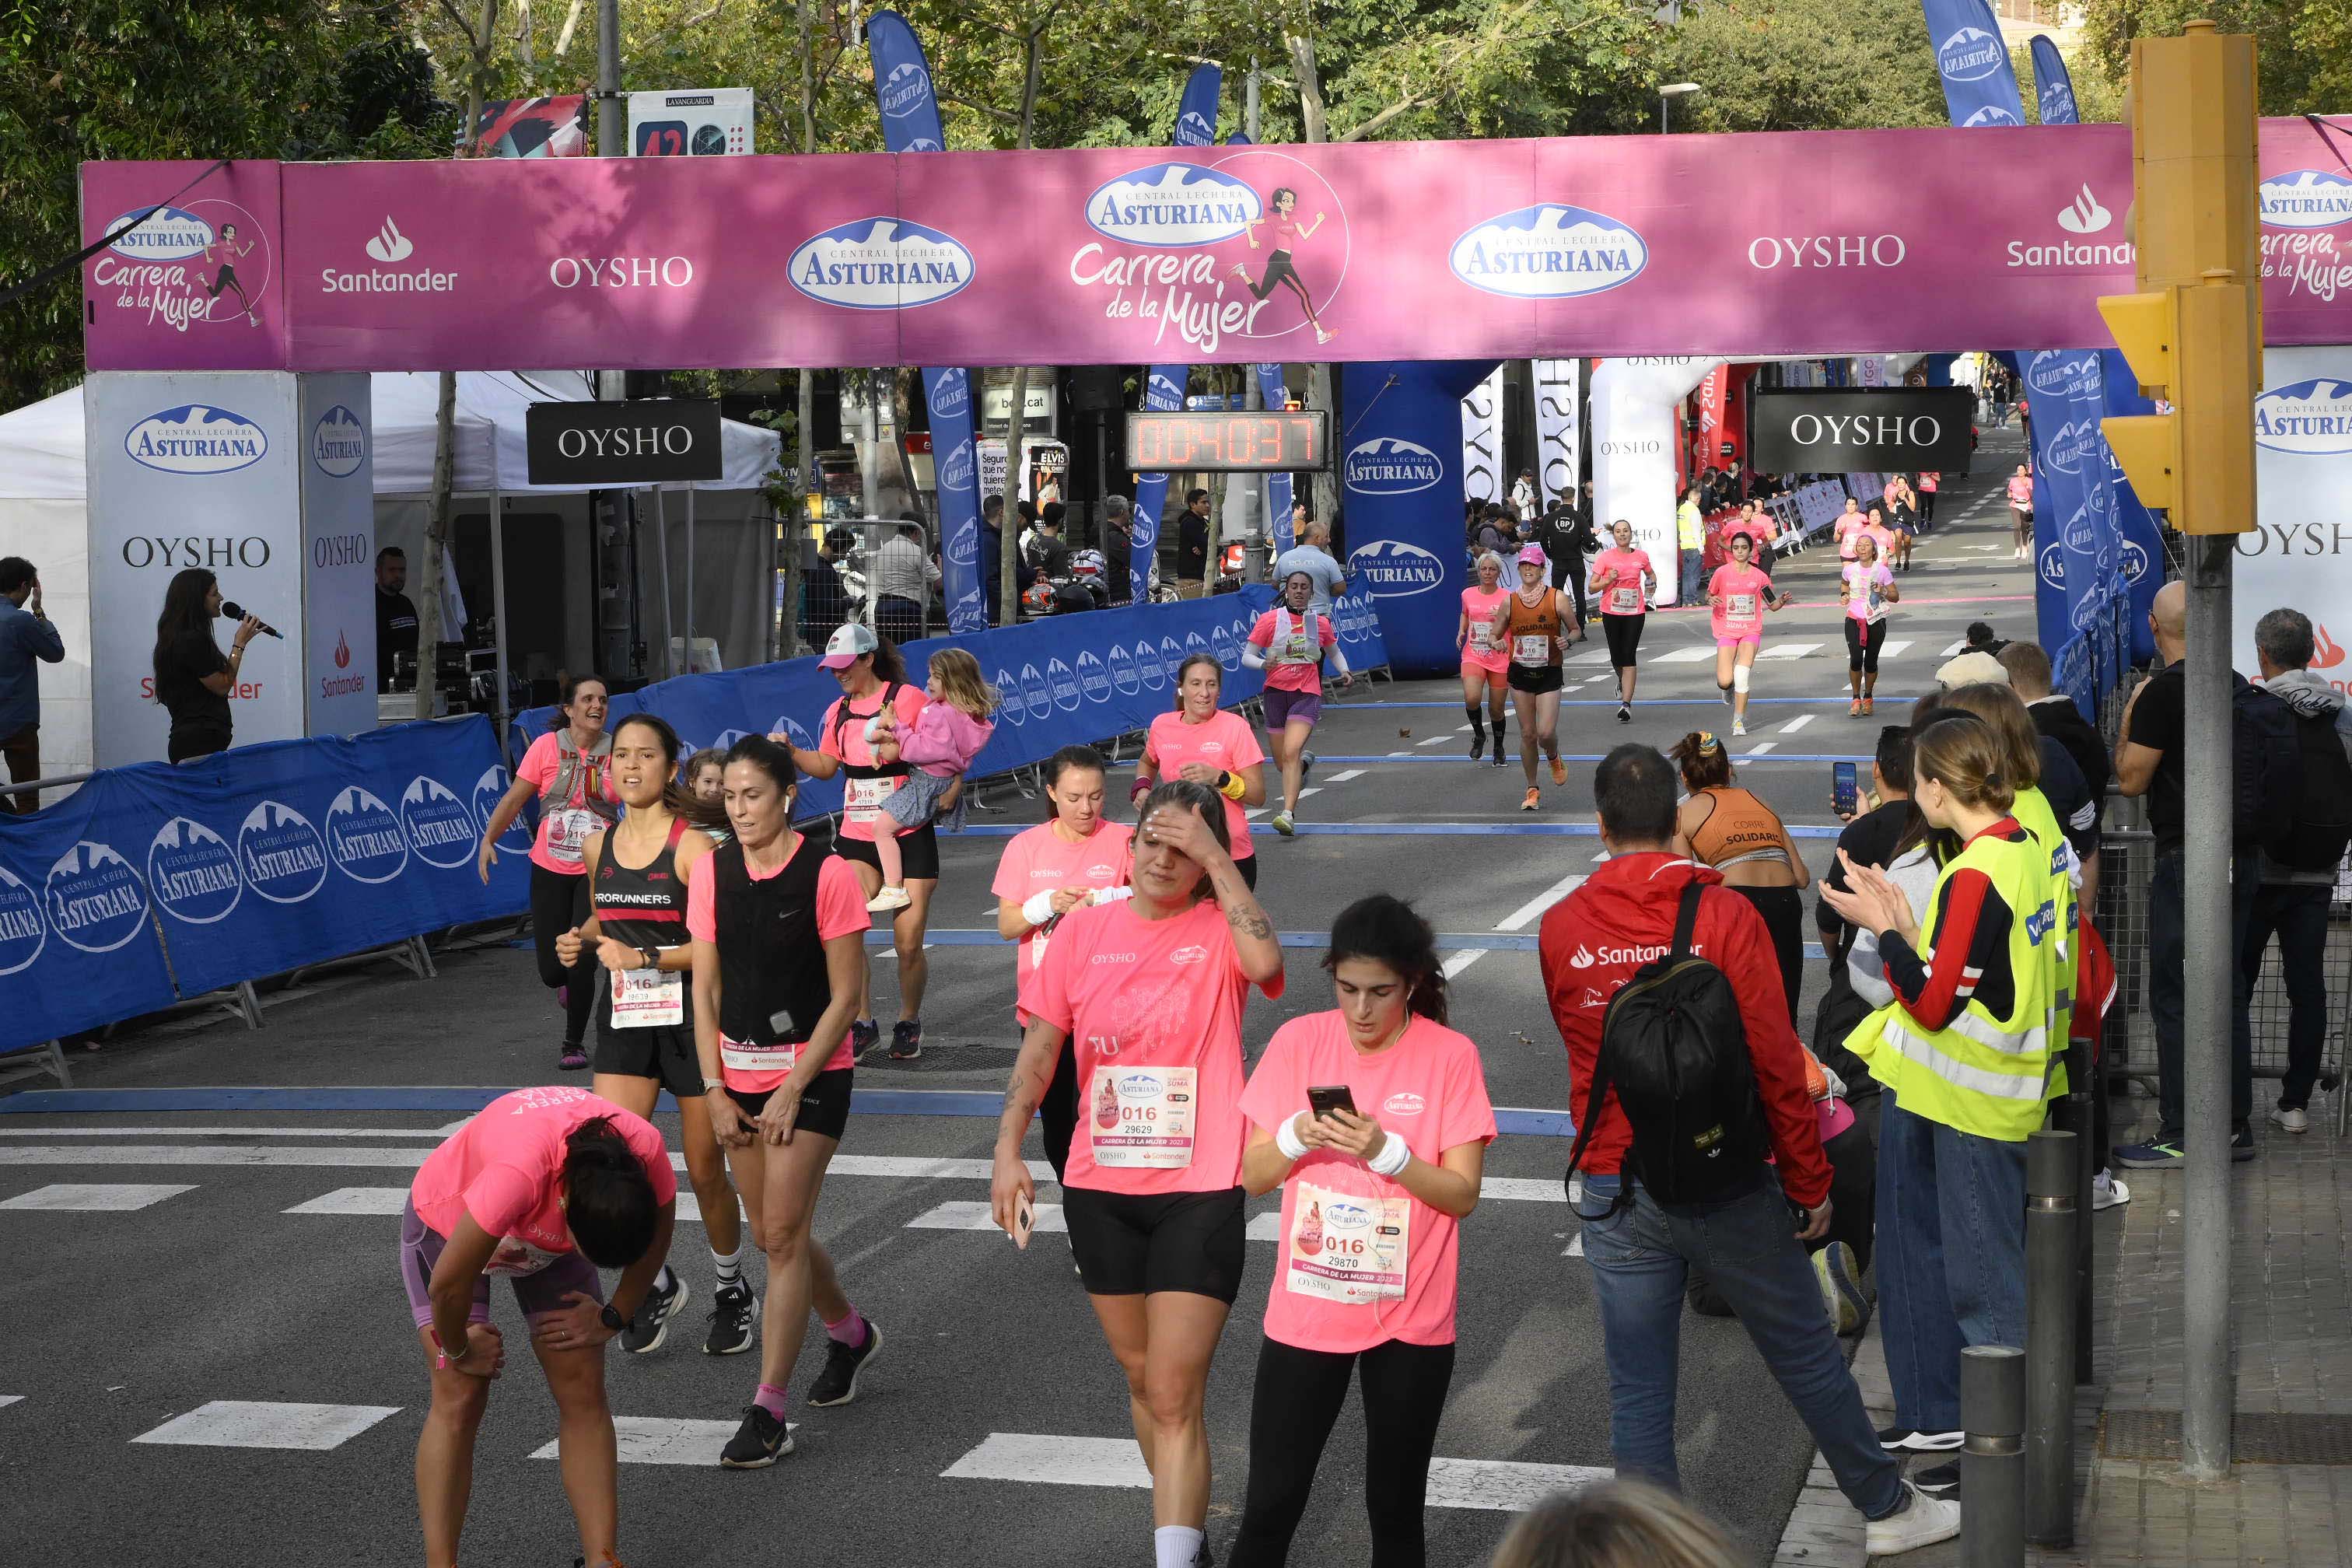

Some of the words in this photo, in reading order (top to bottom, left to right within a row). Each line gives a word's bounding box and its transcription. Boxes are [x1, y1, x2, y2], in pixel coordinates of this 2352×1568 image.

[676, 97, 713, 106] VANGUARDIA
[645, 130, 681, 156] 42
[1187, 191, 1244, 199] LECHERA
[1099, 194, 1246, 226] ASTURIANA
[1563, 235, 1627, 245] LECHERA
[1748, 234, 1906, 268] OYSHO
[2260, 232, 2334, 255] arrera
[831, 249, 889, 258] CENTRAL
[895, 248, 954, 257] LECHERA
[1069, 243, 1216, 286] Carrera
[1465, 241, 1632, 275] ASTURIANA
[2007, 240, 2136, 268] Santand
[94, 257, 187, 286] Carrera
[322, 268, 457, 293] Santander
[550, 257, 693, 289] OYSHO
[802, 251, 961, 286] ASTURIANA
[2279, 255, 2292, 277] la
[2289, 250, 2352, 302] Muje
[117, 288, 135, 308] de
[138, 288, 149, 308] la
[148, 283, 220, 332] Mujer
[1106, 288, 1132, 319] de
[1139, 288, 1158, 319] la
[1153, 280, 1270, 354] Mujer
[2277, 404, 2328, 413] CENTRAL
[1790, 414, 1941, 447] OYSHO
[2255, 407, 2352, 436] ASTURI
[136, 430, 257, 457] ASTURIANA
[317, 432, 362, 460] ASTURIANA
[558, 425, 692, 458] OYSHO
[1138, 420, 1313, 463] 00:40:37
[1601, 439, 1660, 456] OYSHO
[1041, 453, 1065, 463] ELVIS
[983, 467, 996, 476] que
[983, 475, 1006, 485] quiere
[1348, 460, 1436, 482] ASTURIANA
[122, 537, 271, 569] OYSHO
[315, 533, 366, 568] OYSHO
[321, 673, 366, 698] Santander
[857, 789, 874, 798] 016
[407, 814, 474, 849] ASTURIANA
[1734, 820, 1766, 830] CORRE
[333, 826, 405, 863] ASTURIANA
[246, 843, 324, 884] ASTURIANA
[1031, 870, 1062, 878] OYSHO
[157, 861, 239, 902] ASTURIANA
[1091, 952, 1136, 965] OYSHO
[625, 978, 652, 991] 016
[1121, 1083, 1159, 1093] ASTURIANA
[1122, 1107, 1157, 1121] 016
[1386, 1100, 1425, 1110] ASTURIANA
[1125, 1125, 1152, 1134] 29629
[1100, 1151, 1126, 1160] OYSHO
[1328, 1209, 1367, 1224] ASTURIANA
[1325, 1236, 1364, 1254] 016
[1302, 1264, 1329, 1276] CARRERA
[1328, 1255, 1358, 1268] 29870
[1297, 1276, 1331, 1291] OYSHO
[1356, 1288, 1395, 1299] Santander
